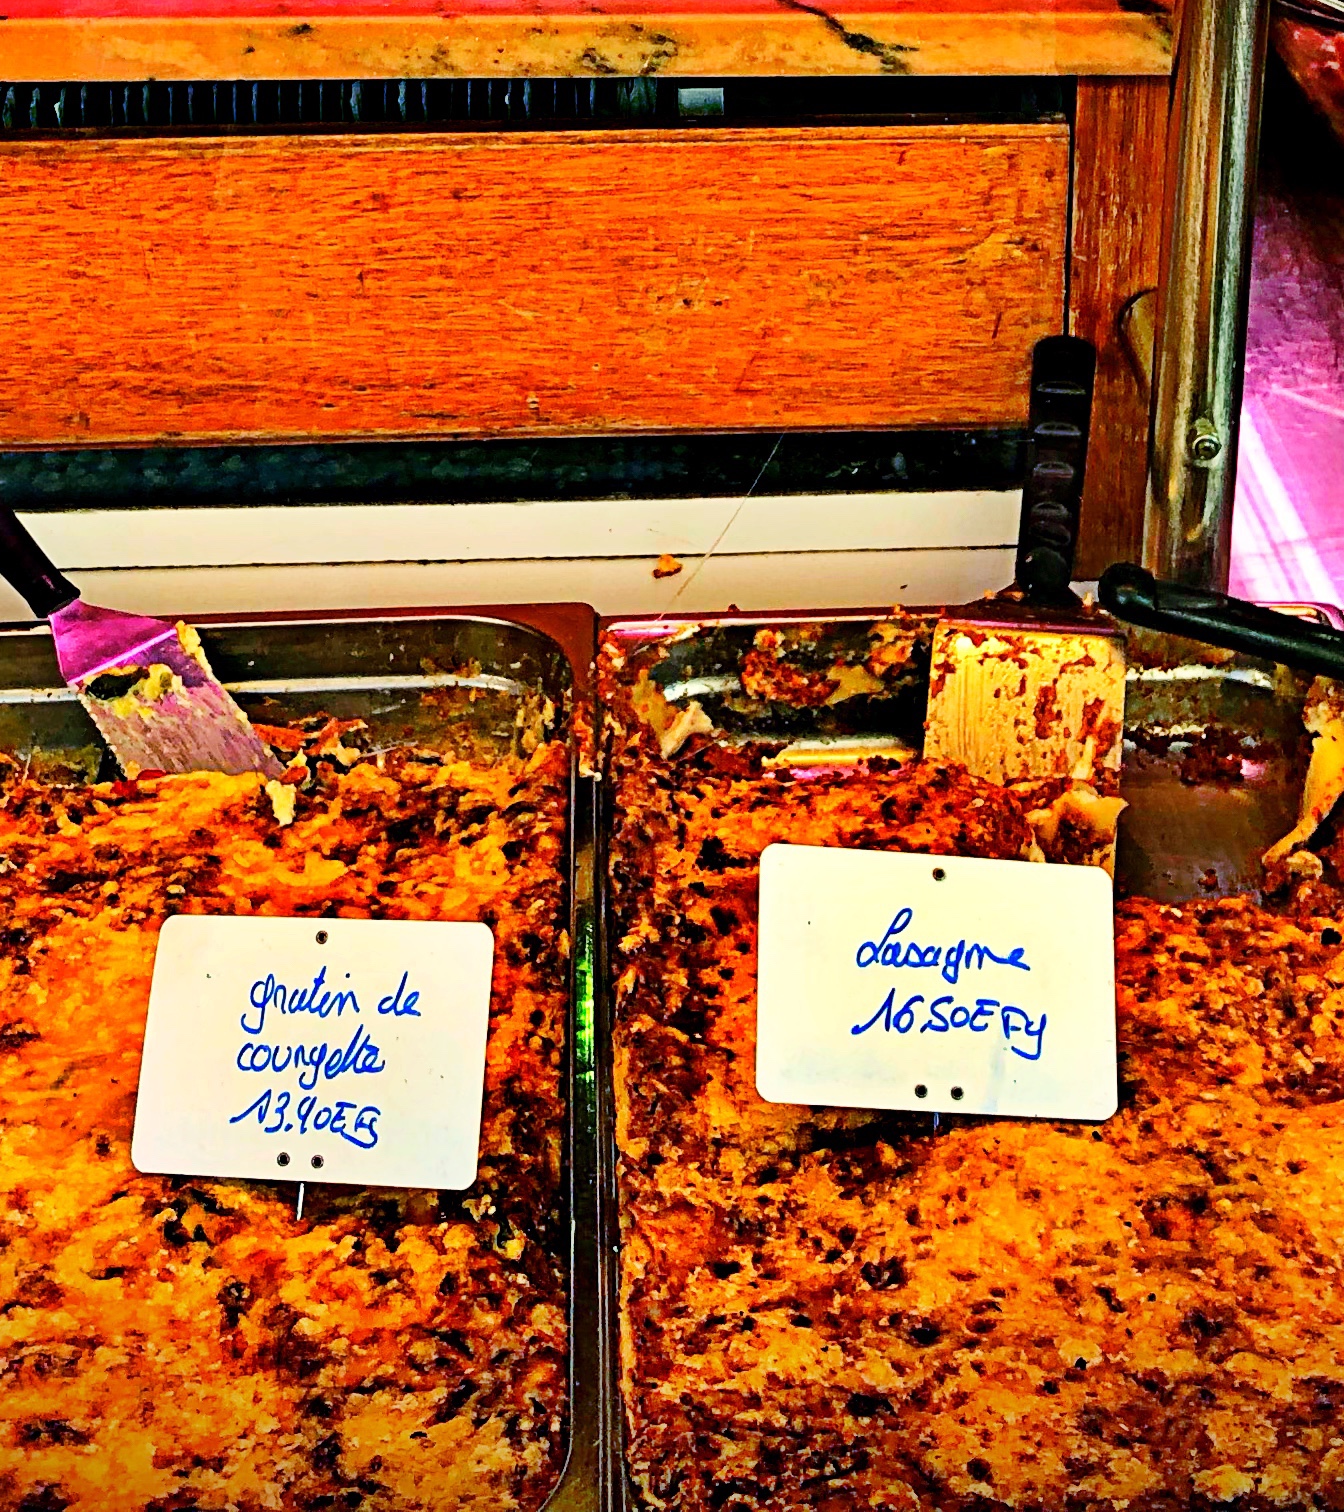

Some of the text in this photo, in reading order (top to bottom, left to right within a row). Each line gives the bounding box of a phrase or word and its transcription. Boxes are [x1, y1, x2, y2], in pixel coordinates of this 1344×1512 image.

[856, 908, 1031, 984] Lasagne
[241, 966, 421, 1034] gratin de
